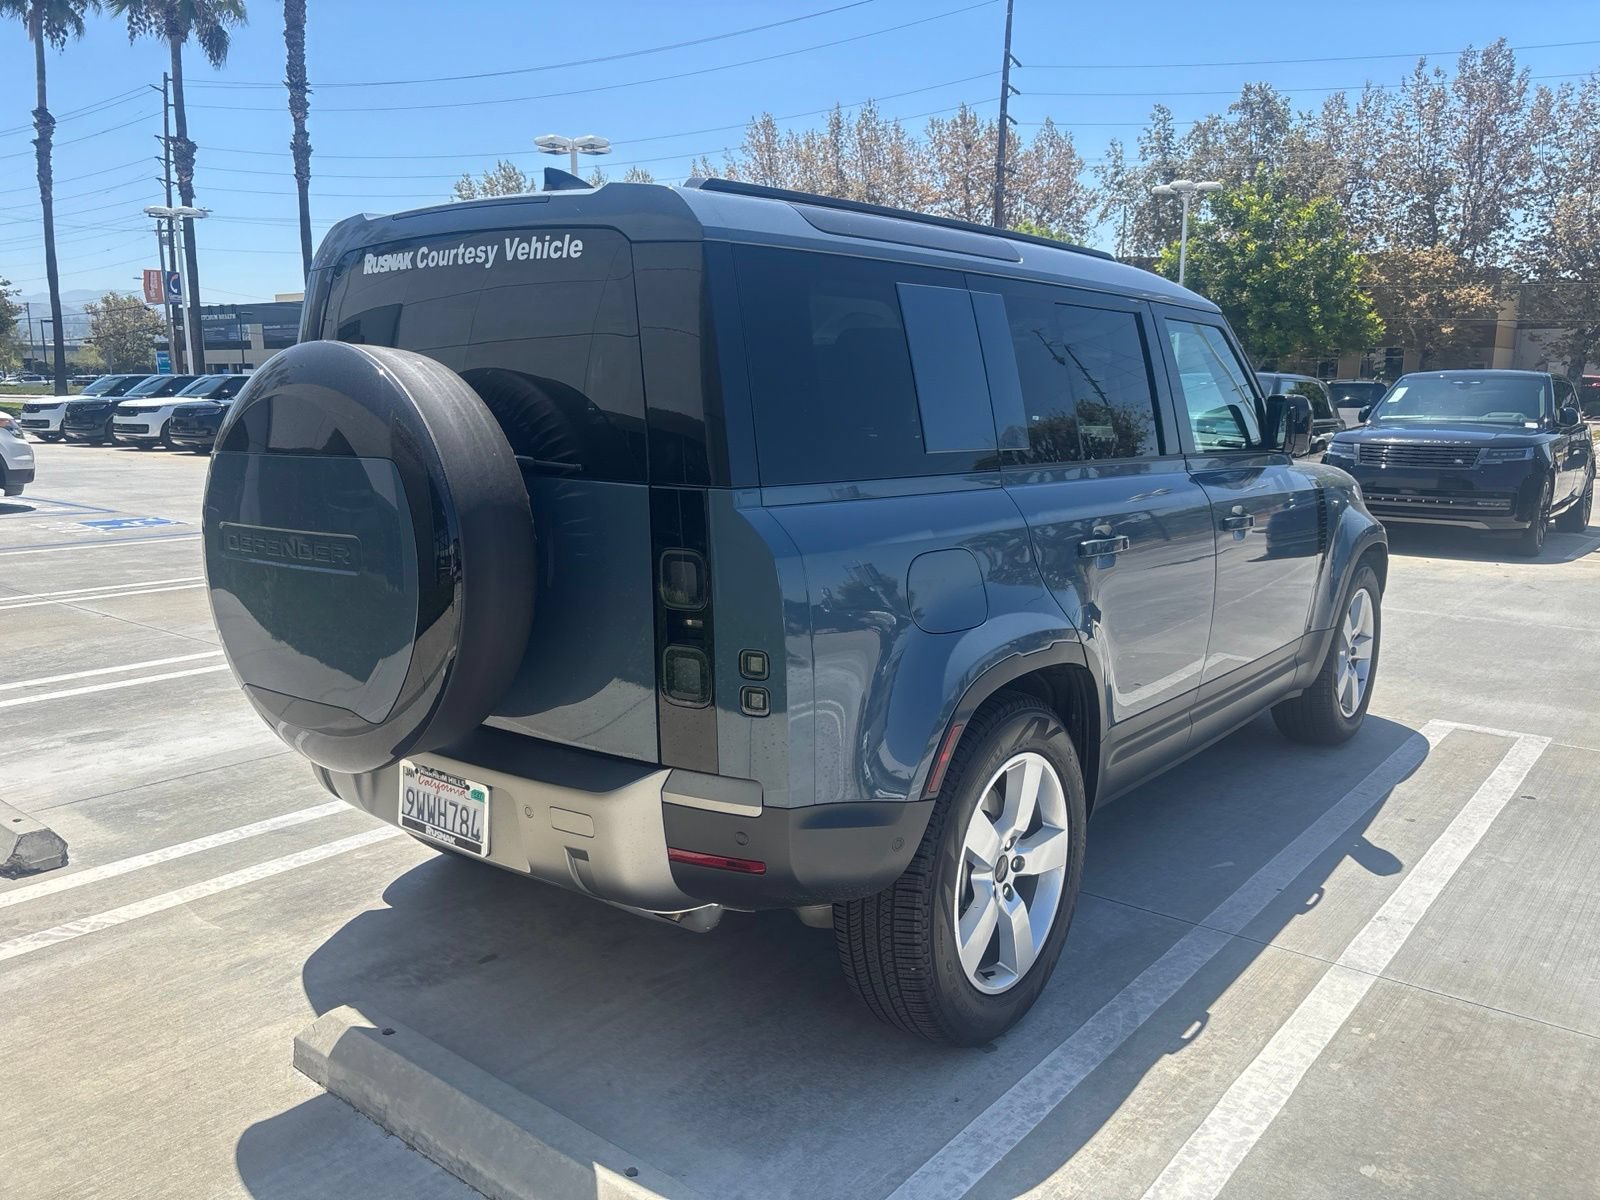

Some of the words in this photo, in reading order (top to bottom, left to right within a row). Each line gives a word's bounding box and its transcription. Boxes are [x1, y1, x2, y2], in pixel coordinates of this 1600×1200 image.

[363, 252, 413, 274] RUSNAK
[416, 243, 498, 268] Courtesy
[504, 234, 584, 261] Vehicle
[227, 534, 351, 565] DEFENDER
[417, 774, 471, 801] California
[448, 776, 466, 788] HILLS
[405, 788, 482, 841] 9WWH784
[425, 825, 457, 845] RUSNAK
